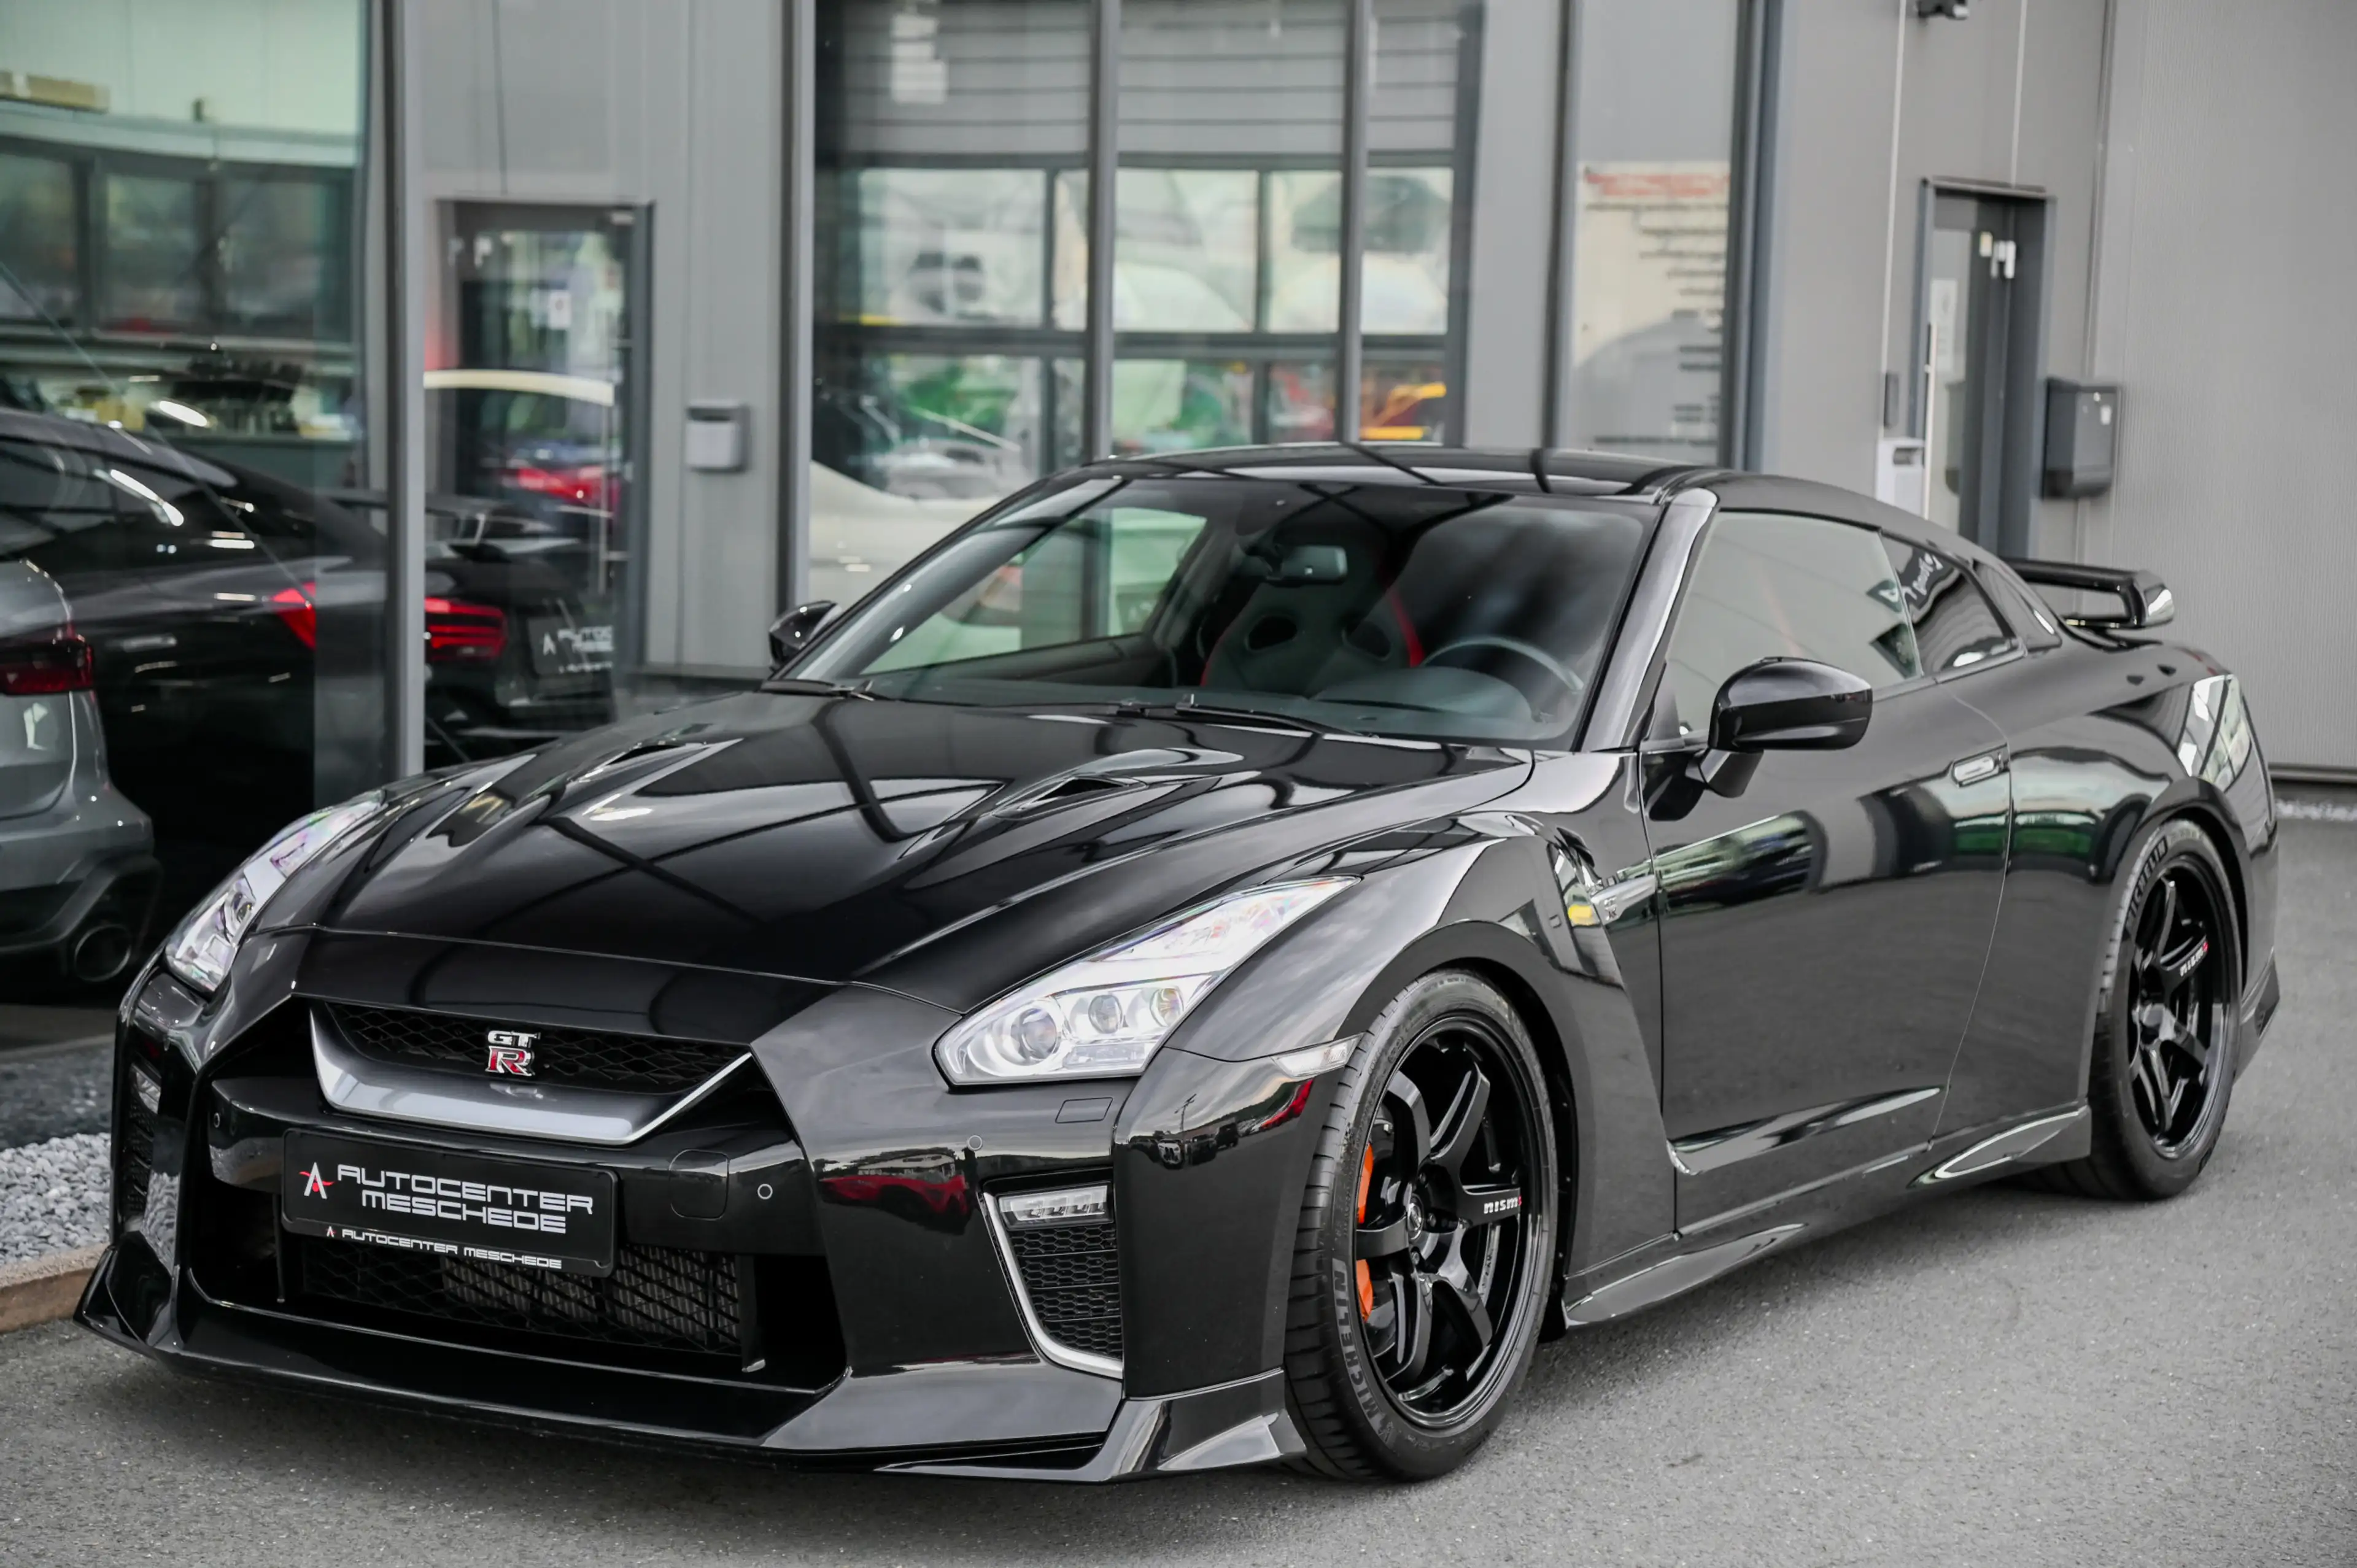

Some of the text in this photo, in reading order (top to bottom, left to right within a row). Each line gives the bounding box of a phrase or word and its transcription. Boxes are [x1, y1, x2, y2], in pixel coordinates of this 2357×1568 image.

[485, 1045, 535, 1076] R
[487, 1030, 541, 1048] GT
[338, 1164, 593, 1215] AUTOCENTER
[362, 1189, 566, 1234] MESCHEDE
[342, 1228, 458, 1254] AUTOCENTER
[463, 1246, 562, 1269] MESCHEDE
[1333, 1269, 1380, 1420] MICHELIN
